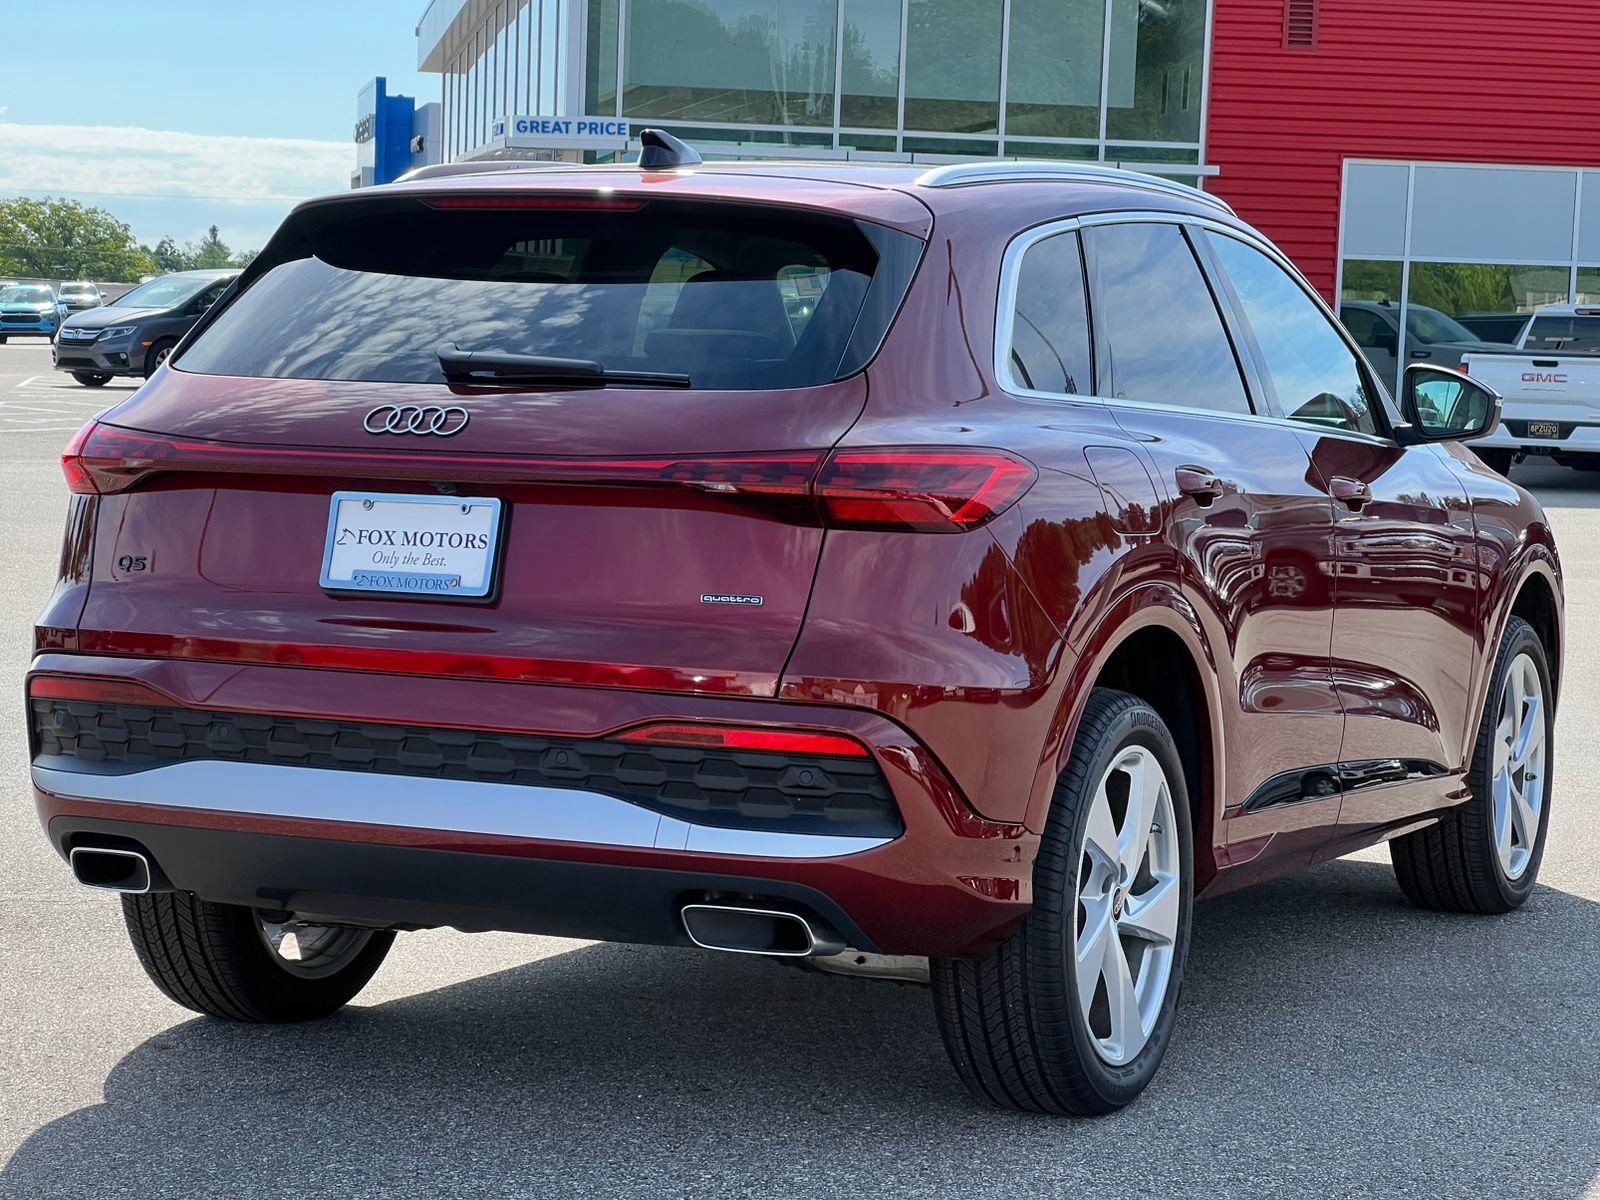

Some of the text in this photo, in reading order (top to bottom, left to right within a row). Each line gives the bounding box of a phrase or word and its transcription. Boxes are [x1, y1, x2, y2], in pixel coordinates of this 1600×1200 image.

[516, 120, 572, 134] GREAT
[577, 121, 627, 136] PRICE
[1521, 373, 1568, 383] GMC
[356, 529, 488, 549] FOX MOTORS
[118, 554, 147, 572] Q5
[372, 551, 447, 568] Only the Best.
[369, 575, 450, 591] FOX MOTORS
[703, 595, 760, 604] quattro
